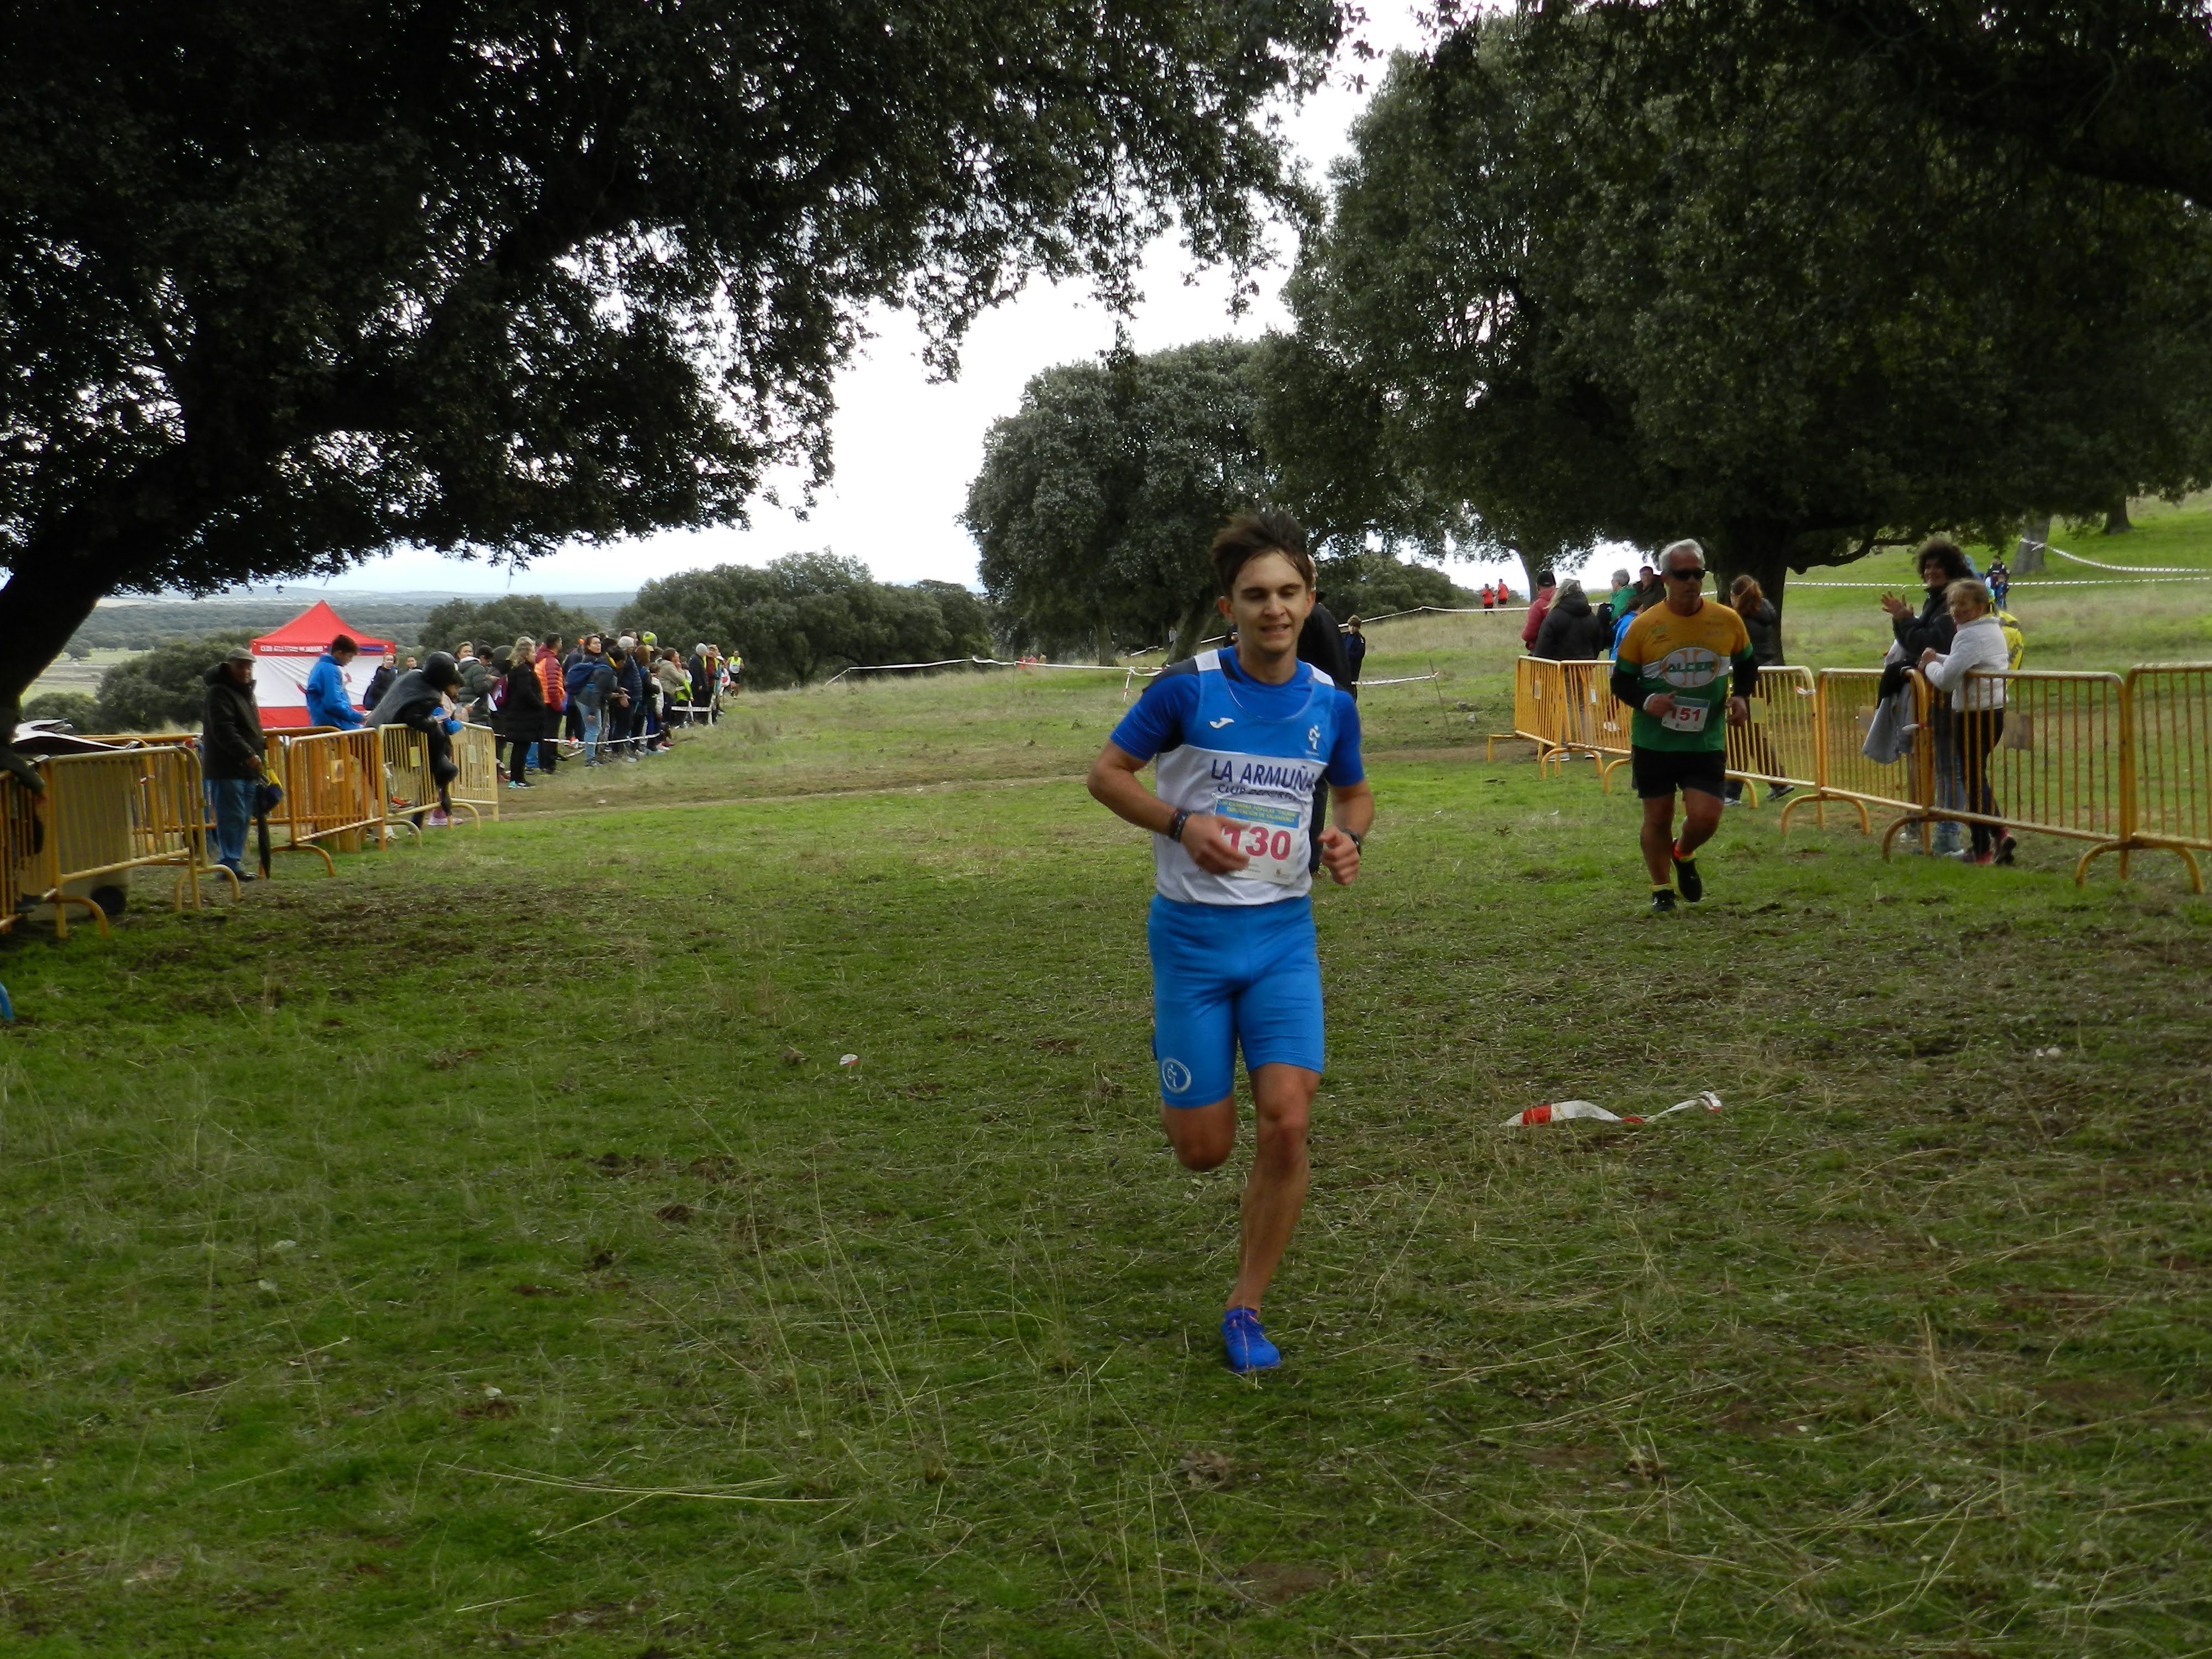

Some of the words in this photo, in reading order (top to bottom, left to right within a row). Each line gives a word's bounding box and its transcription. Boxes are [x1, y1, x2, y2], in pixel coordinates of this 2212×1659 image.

[1671, 707, 1701, 722] 151
[1211, 759, 1233, 782] LA
[1240, 763, 1314, 791] ARMUÑA
[1224, 826, 1291, 860] 130
